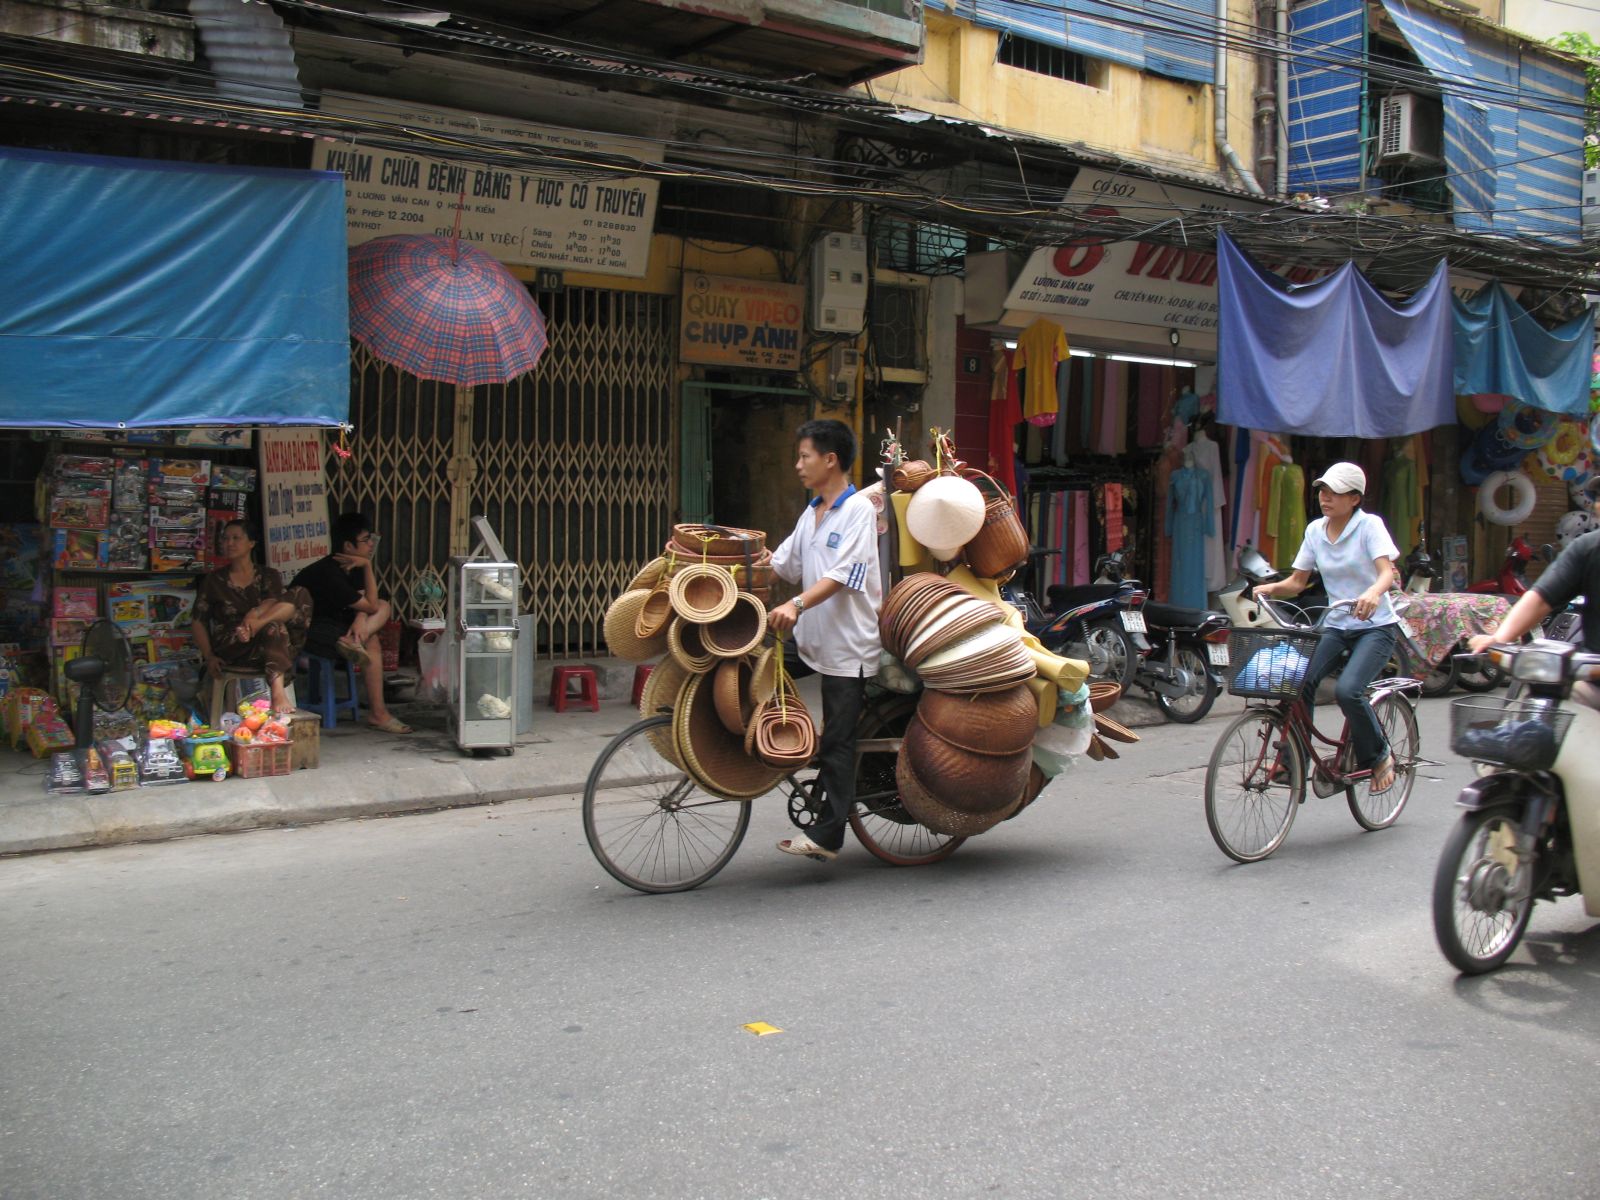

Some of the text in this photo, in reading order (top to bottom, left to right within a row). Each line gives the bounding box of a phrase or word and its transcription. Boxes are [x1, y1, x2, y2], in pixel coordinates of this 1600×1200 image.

[326, 149, 373, 183] KHÁM
[381, 156, 420, 189] CHỮA
[427, 161, 468, 195] BỆNH
[520, 175, 530, 202] Y
[536, 177, 565, 209] HỌC
[412, 198, 430, 207] CAN
[458, 227, 484, 242] LÀM
[491, 232, 520, 249] VIỆC
[543, 275, 558, 289] 10
[1077, 281, 1095, 293] CAN
[687, 294, 801, 325] QUAY VIDEO
[686, 321, 749, 350] CHỤP
[969, 358, 977, 372] 8
